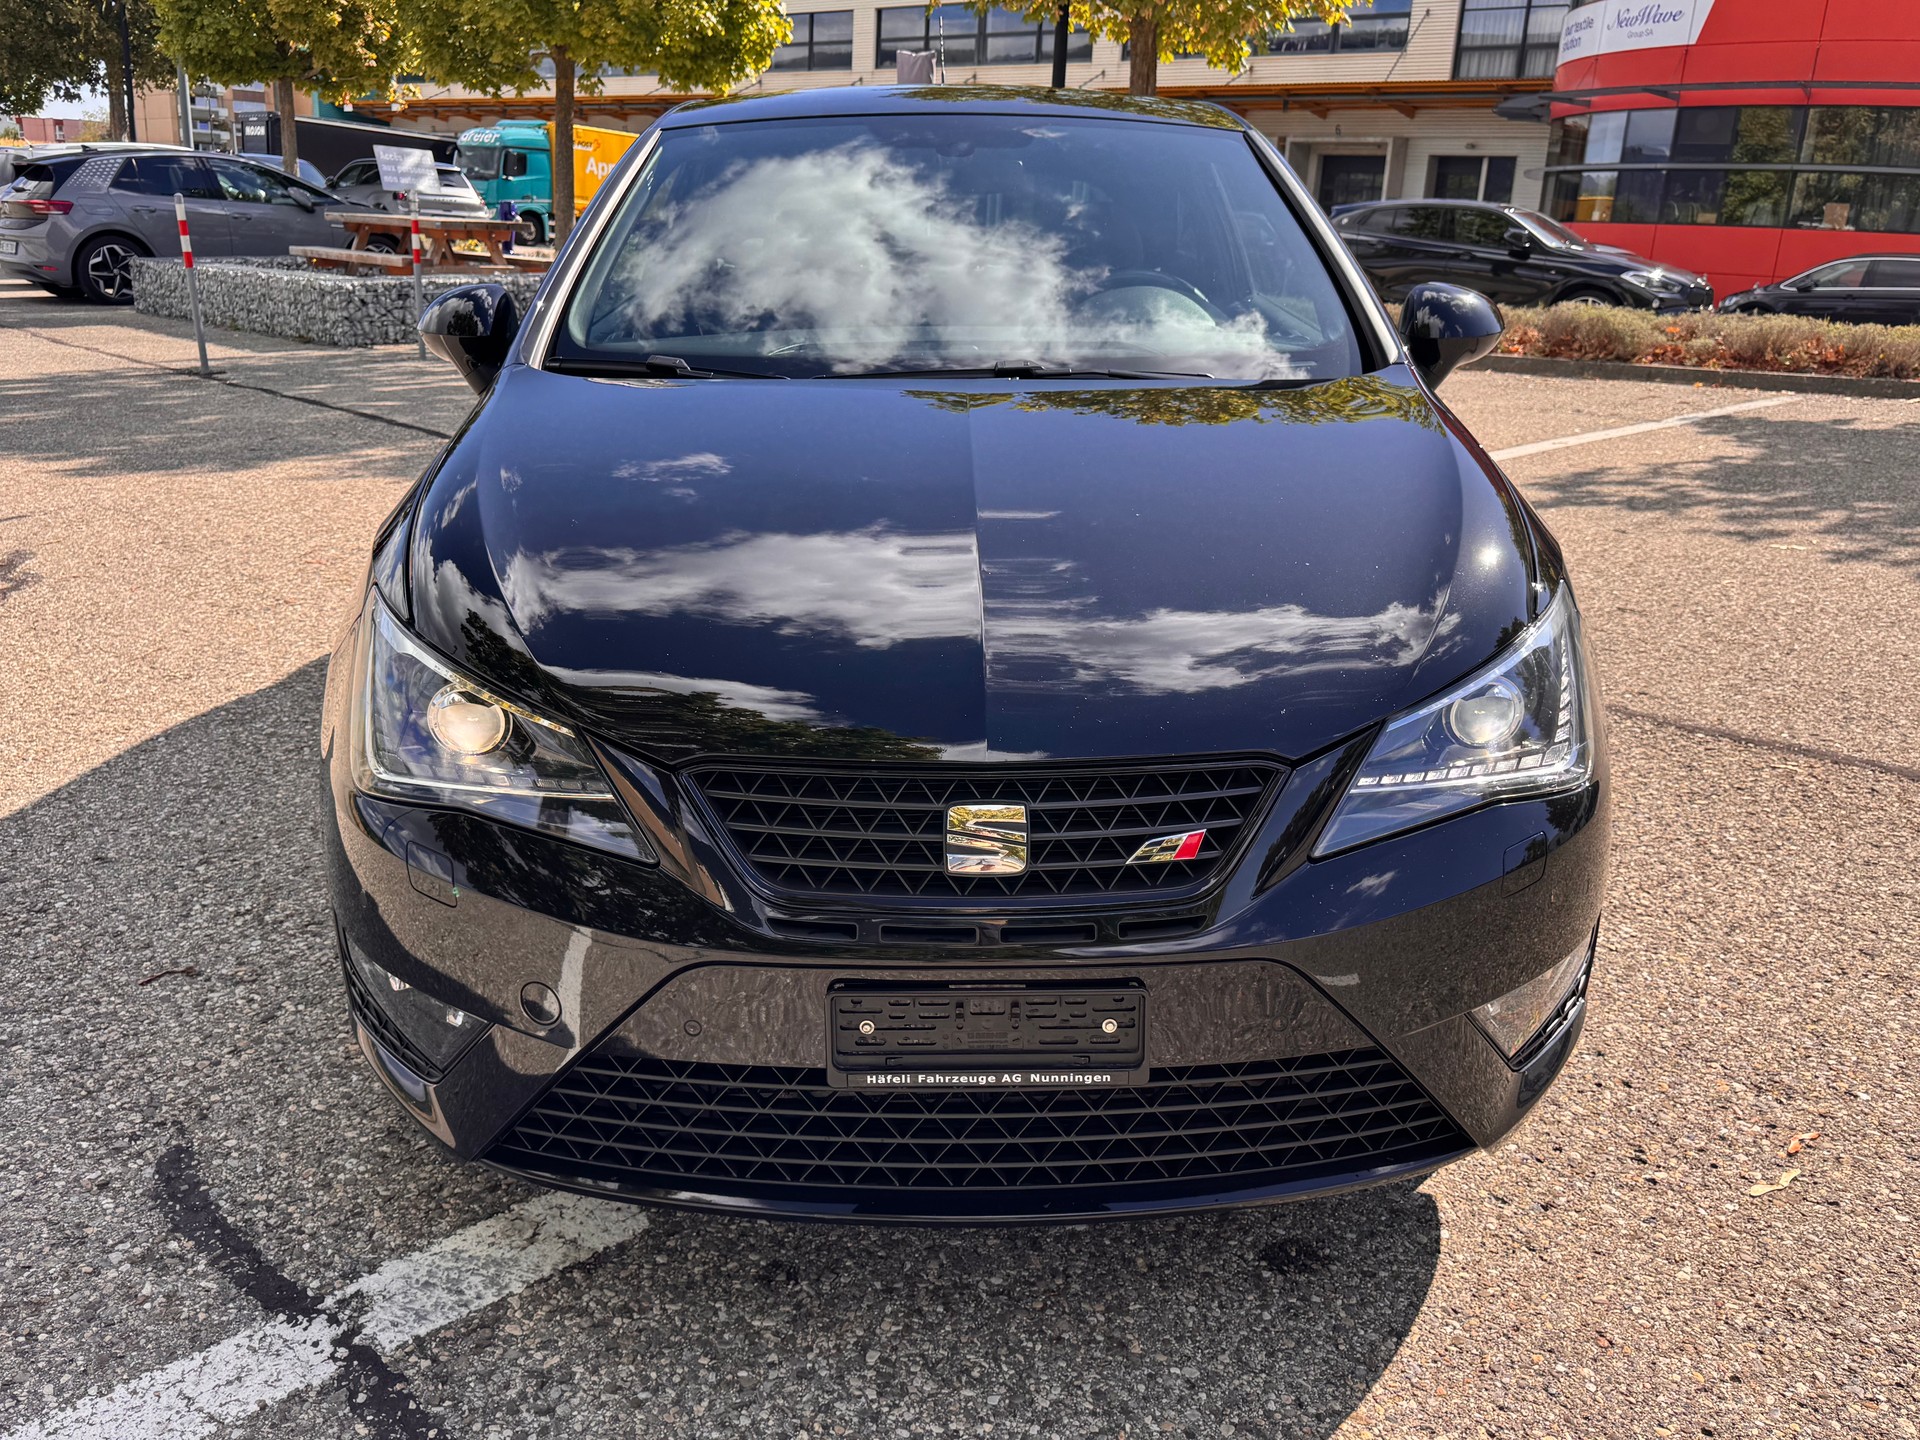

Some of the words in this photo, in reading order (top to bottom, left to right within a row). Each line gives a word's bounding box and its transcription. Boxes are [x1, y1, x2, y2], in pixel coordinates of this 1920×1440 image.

[1627, 30, 1644, 39] Group
[1644, 28, 1654, 36] SA
[866, 1074, 911, 1084] Häfeli
[918, 1074, 996, 1085] Fahrzeuge
[1001, 1073, 1022, 1083] AG
[1030, 1073, 1111, 1084] Nunningen
